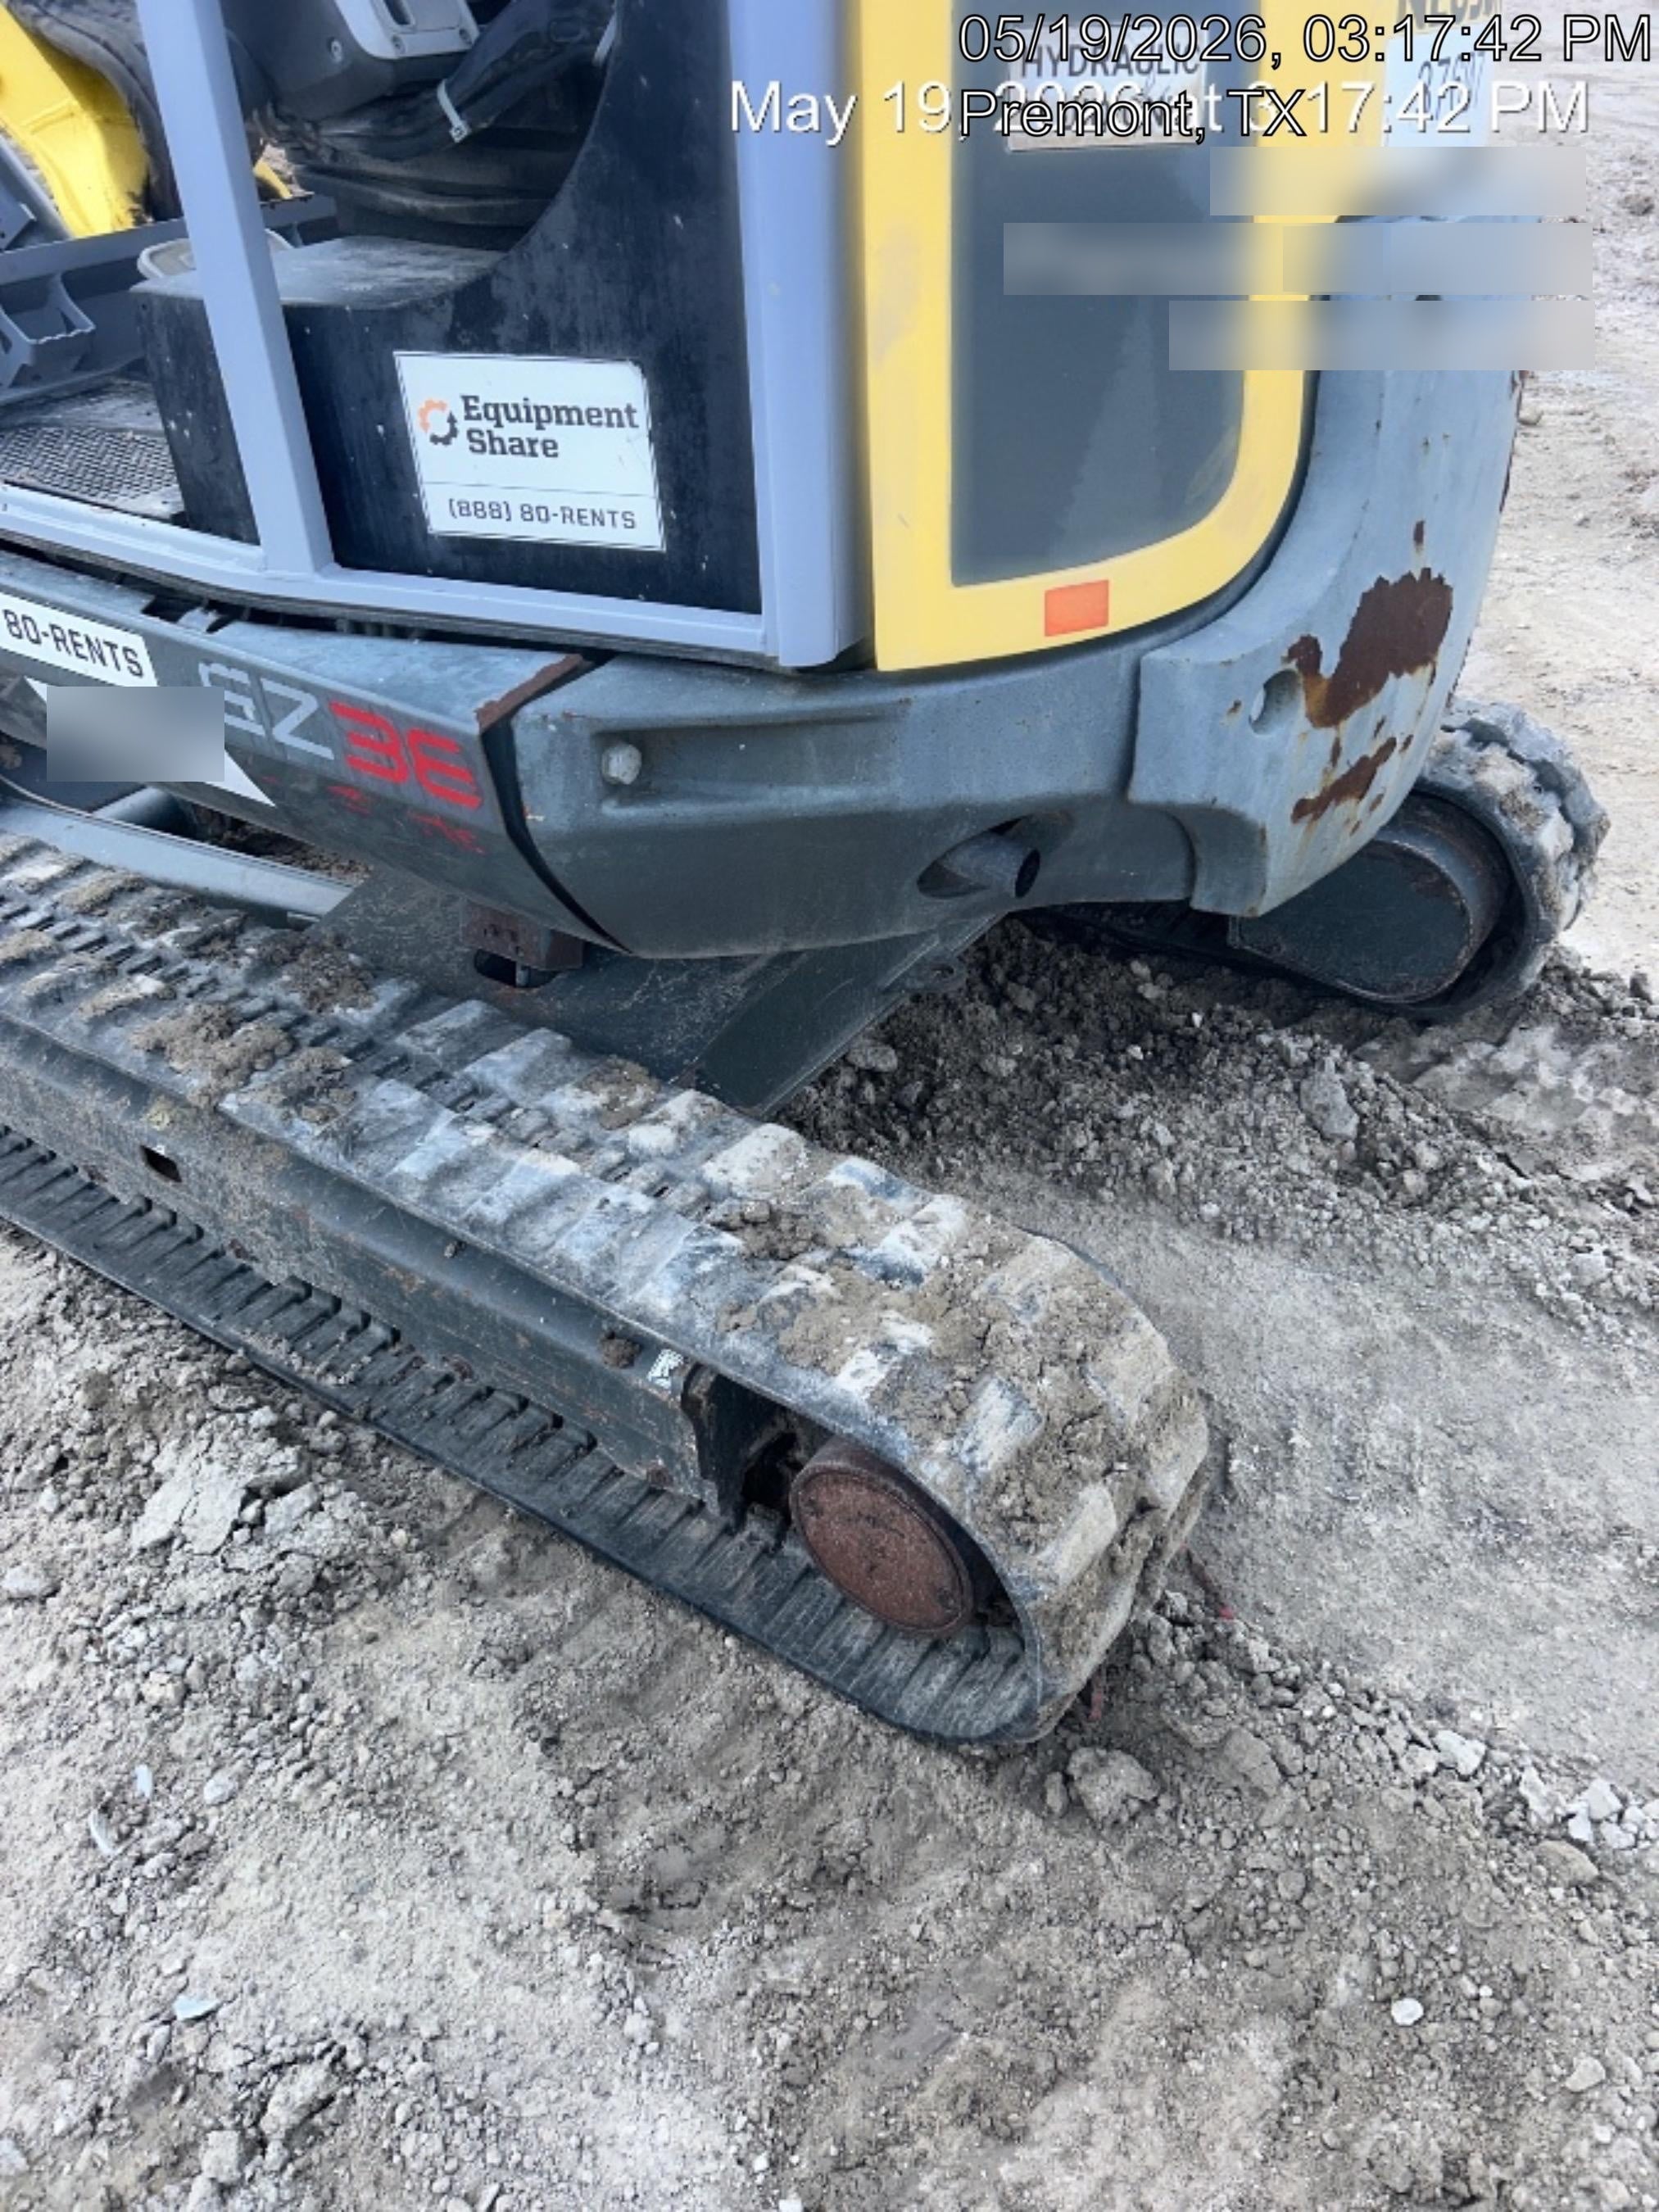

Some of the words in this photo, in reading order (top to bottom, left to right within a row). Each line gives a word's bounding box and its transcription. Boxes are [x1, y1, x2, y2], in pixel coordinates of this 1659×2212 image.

[1021, 43, 1200, 77] HYDRAULIC
[460, 395, 639, 431] Equipment
[466, 428, 560, 459] Share
[448, 498, 512, 523] (888)
[520, 503, 636, 529] 80-RENTS
[2, 609, 144, 679] 80-RENTS
